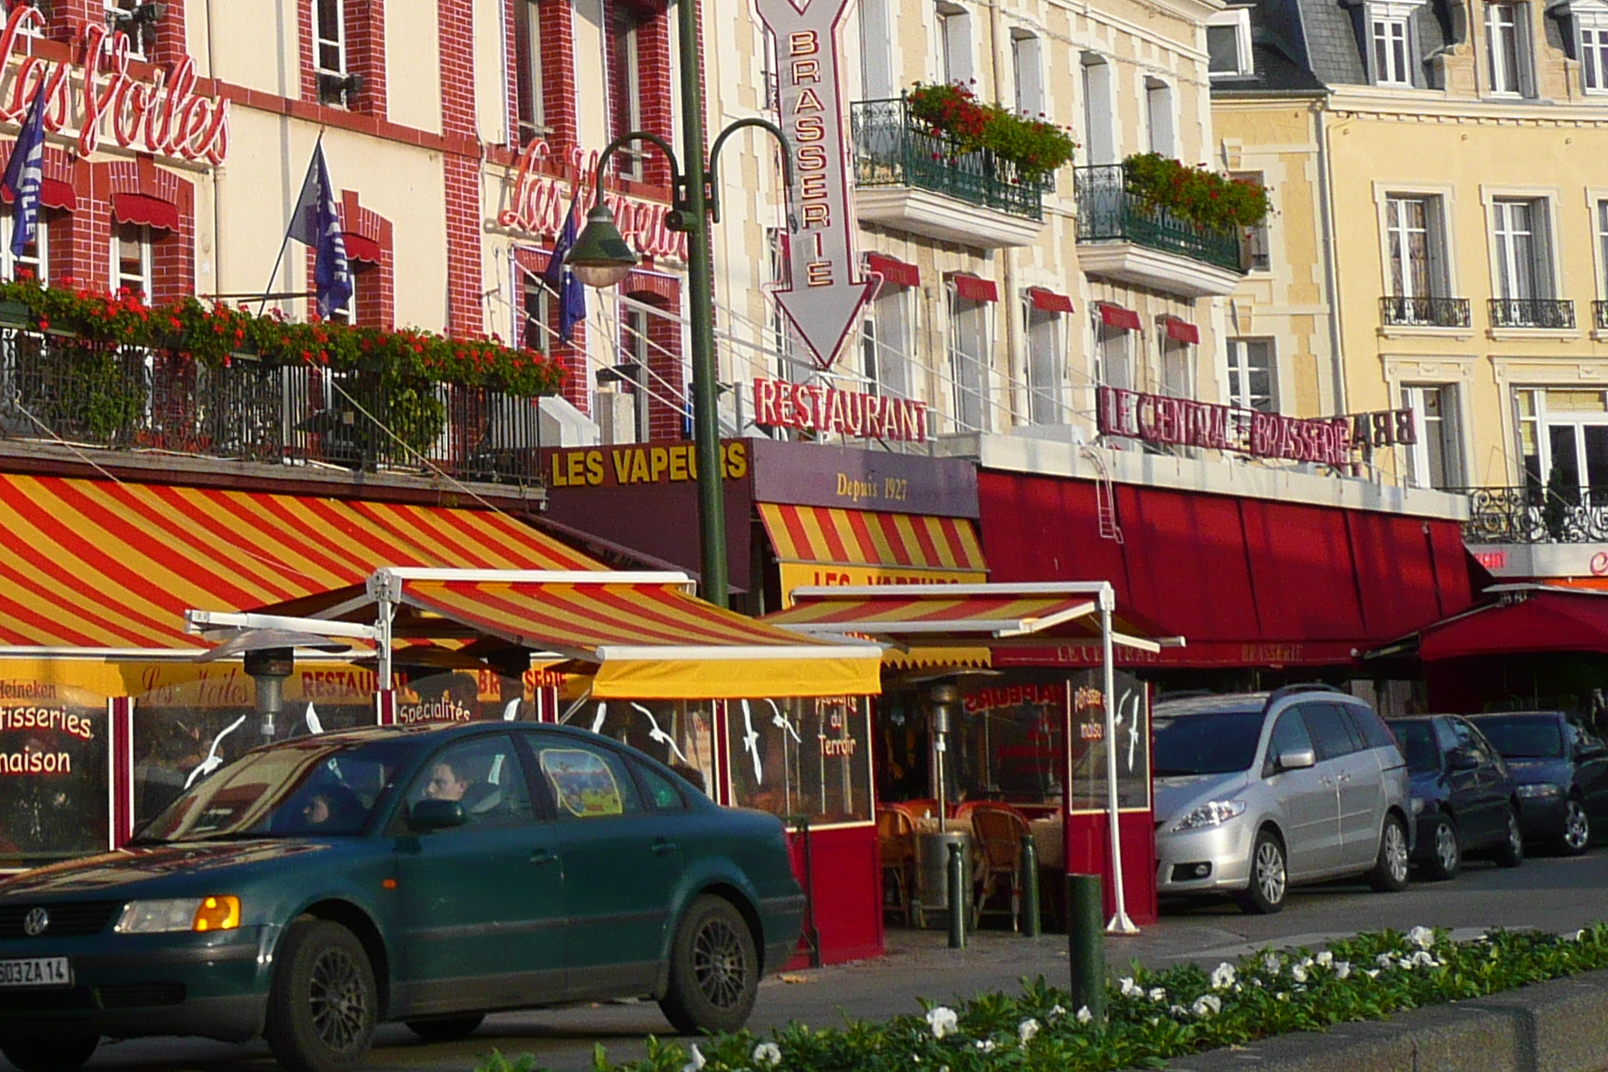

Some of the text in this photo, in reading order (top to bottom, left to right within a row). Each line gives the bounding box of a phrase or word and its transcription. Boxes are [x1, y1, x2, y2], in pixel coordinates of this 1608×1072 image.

[76, 20, 231, 166] Voiles
[789, 30, 834, 288] BRASSERIE
[497, 137, 561, 234] Les
[754, 378, 928, 443] RESTAURANT
[1098, 387, 1350, 465] LE CENTRAL BRASSERIE
[551, 451, 604, 487] LES
[836, 472, 908, 501] Depuis 1927
[1082, 645, 1157, 663] CETRAL
[1242, 644, 1304, 663] BRASSERIE
[138, 666, 250, 705] Les Voiles
[831, 708, 842, 728] du
[817, 733, 857, 756] Terroir
